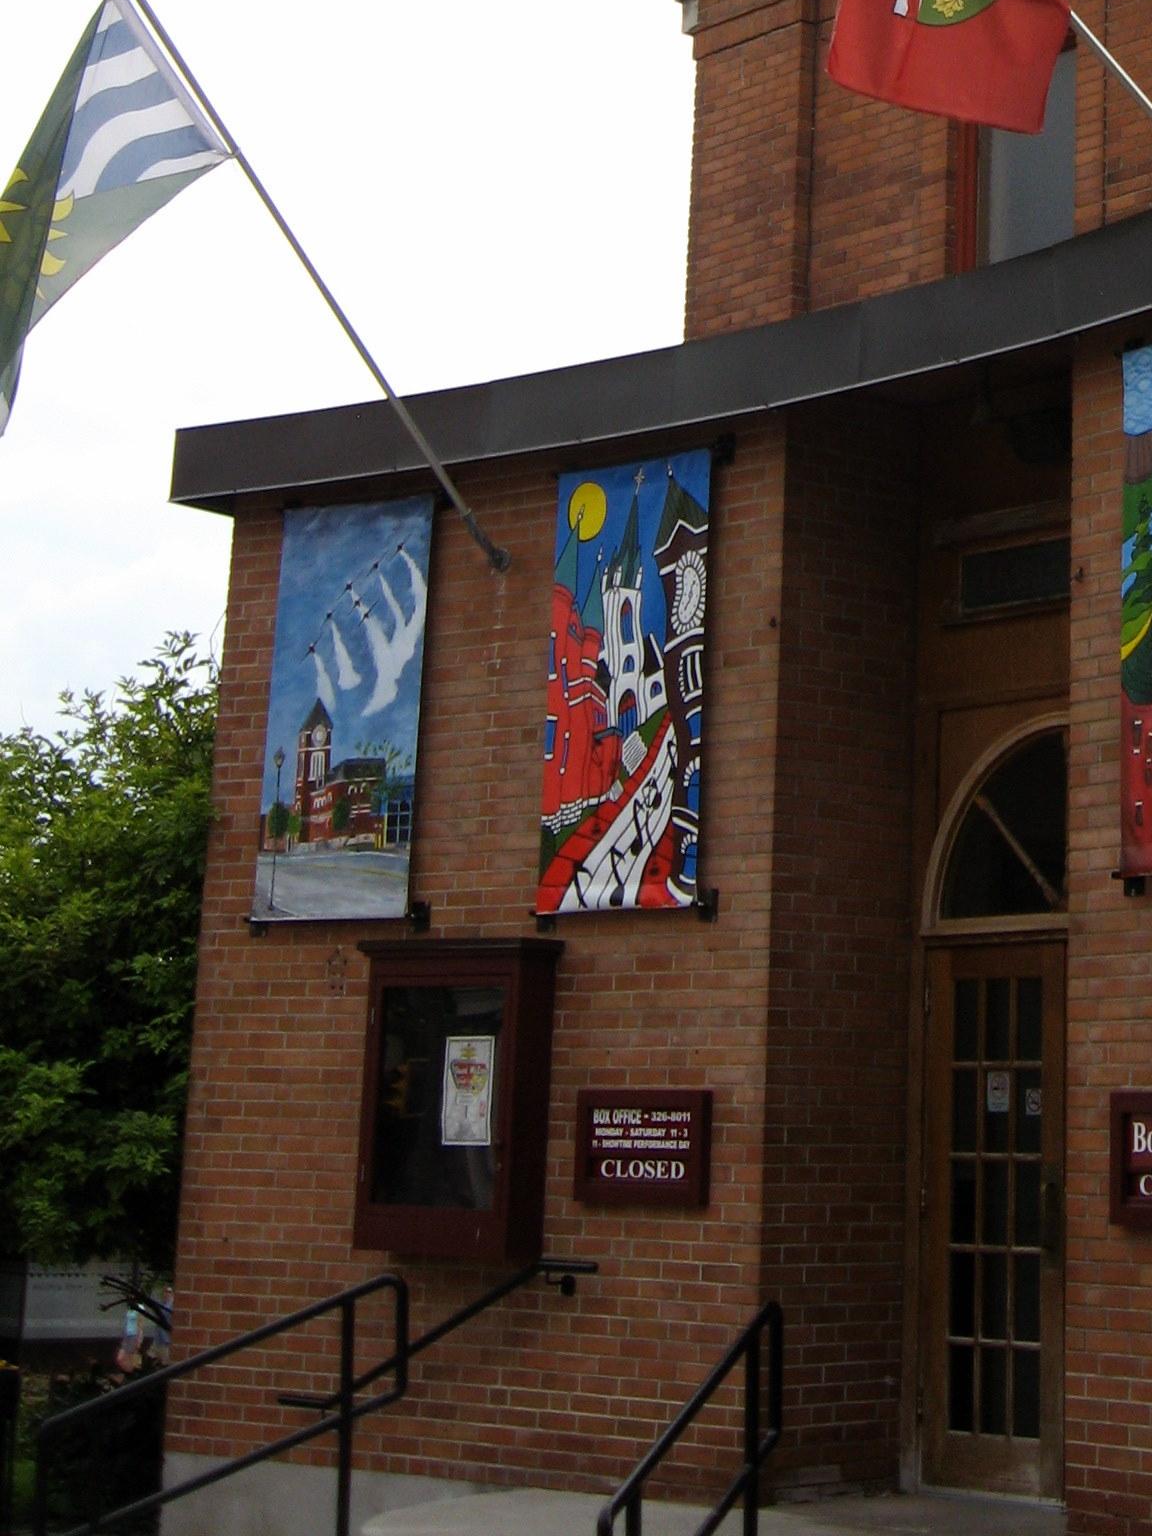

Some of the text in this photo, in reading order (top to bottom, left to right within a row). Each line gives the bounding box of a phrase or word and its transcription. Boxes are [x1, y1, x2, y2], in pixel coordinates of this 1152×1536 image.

[593, 1109, 611, 1124] BOX
[612, 1109, 642, 1124] OFFICE
[595, 1127, 624, 1137] MONDAY
[630, 1128, 666, 1137] SATURDAY
[634, 1140, 678, 1149] PERFORMANCE
[600, 1159, 686, 1180] CLOSED
